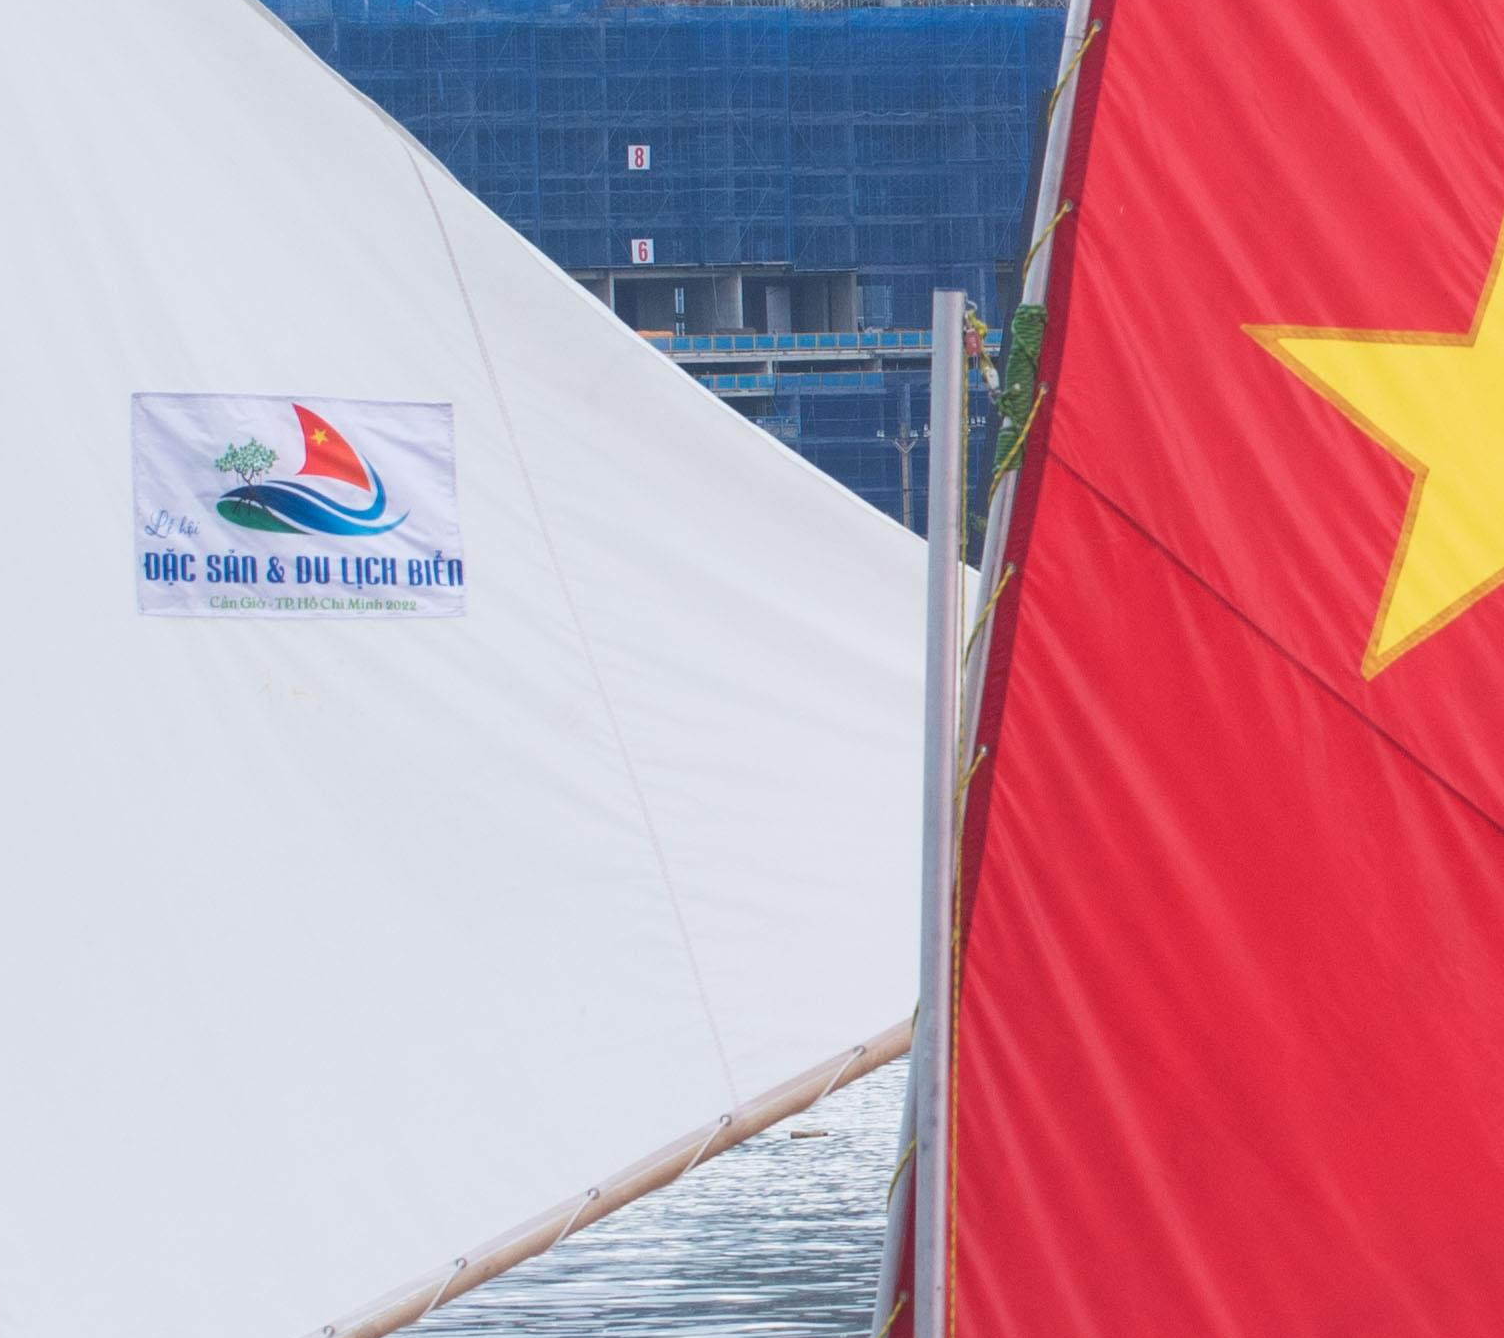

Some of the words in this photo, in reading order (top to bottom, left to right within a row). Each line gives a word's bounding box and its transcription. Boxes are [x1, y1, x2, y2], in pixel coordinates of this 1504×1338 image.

[634, 147, 644, 168] 8
[638, 241, 648, 262] 6
[144, 548, 197, 586] ĐẶC
[266, 556, 286, 583] &
[296, 555, 331, 585] DU
[341, 556, 398, 590] LỊCH
[347, 597, 384, 611] Minh
[385, 598, 418, 612] 2022
